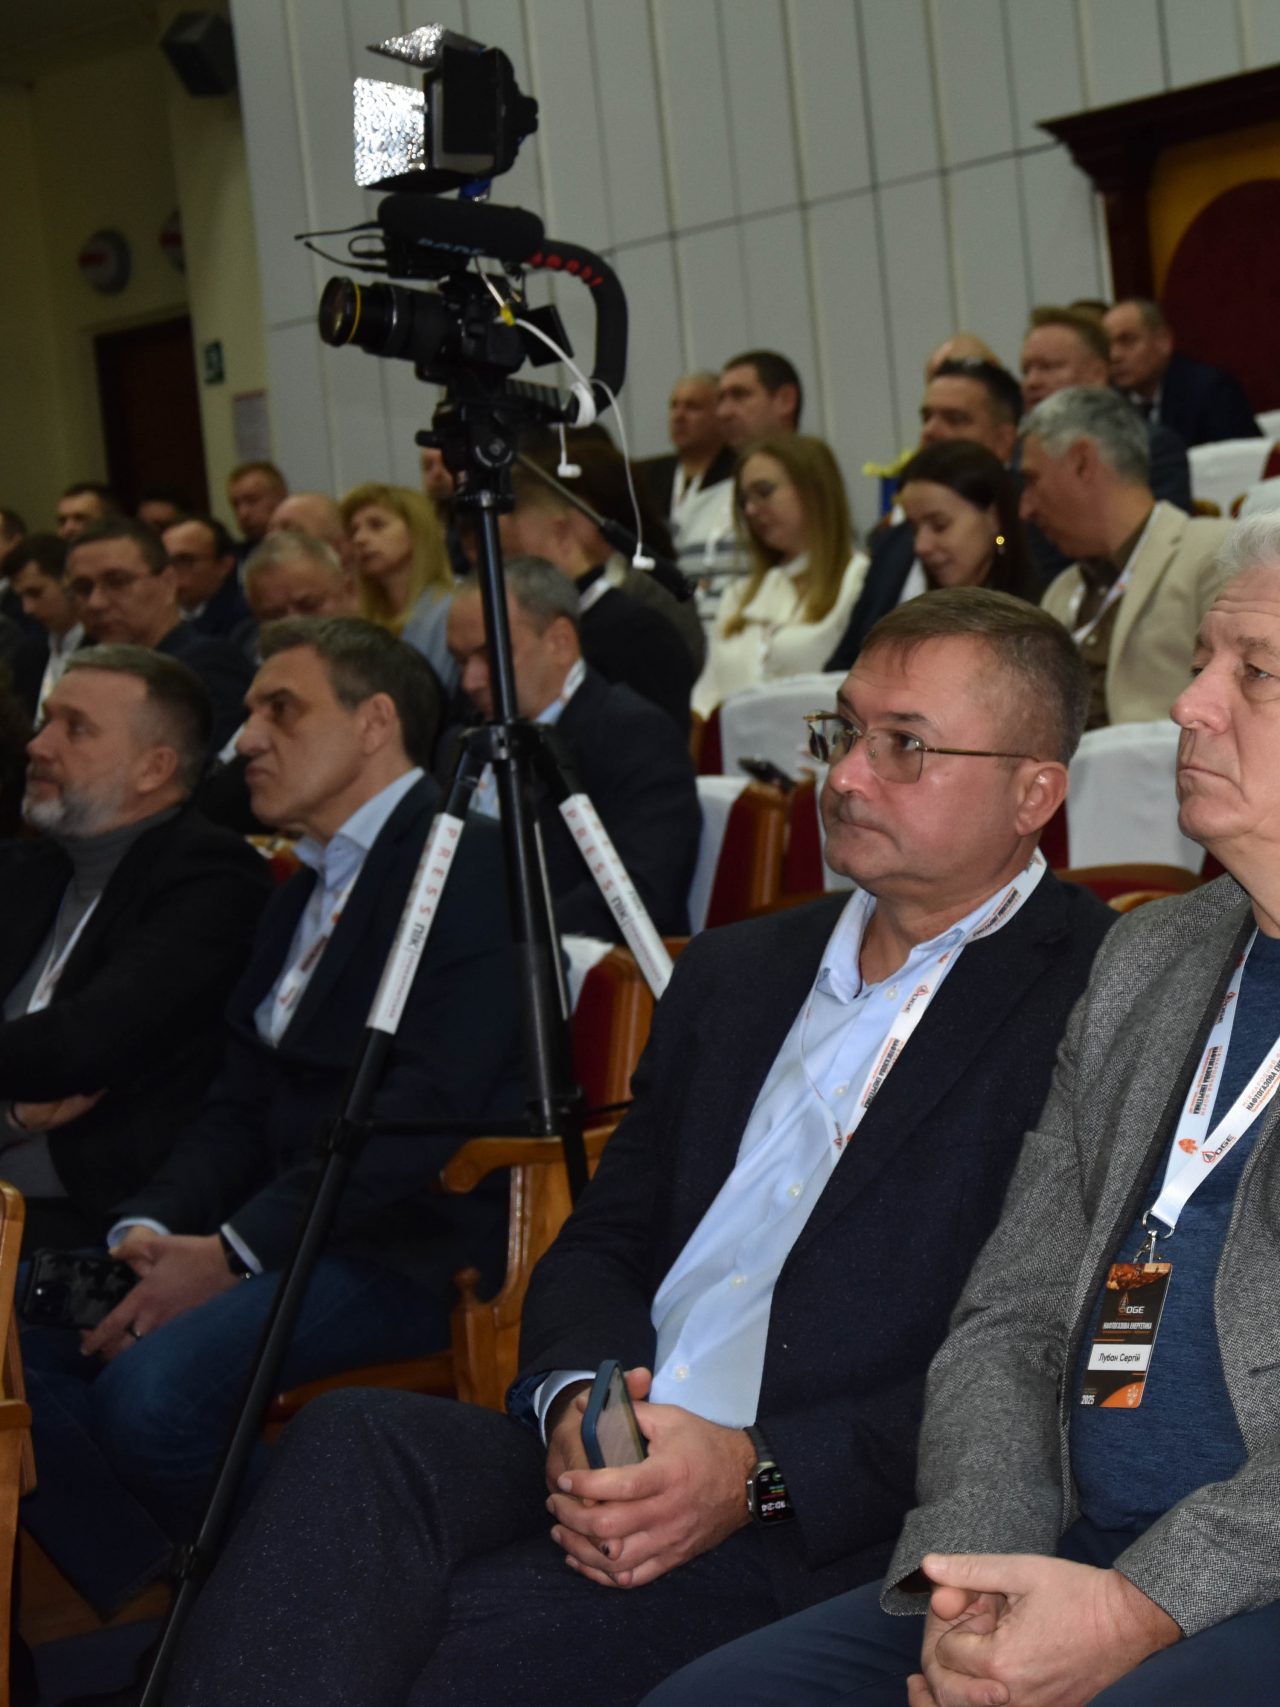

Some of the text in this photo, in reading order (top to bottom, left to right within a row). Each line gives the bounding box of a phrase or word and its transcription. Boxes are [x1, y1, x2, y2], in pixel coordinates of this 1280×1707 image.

[418, 826, 460, 916] PRESS
[565, 808, 614, 893] PRESS
[1246, 1071, 1277, 1111] НАФТОГАЗОВА
